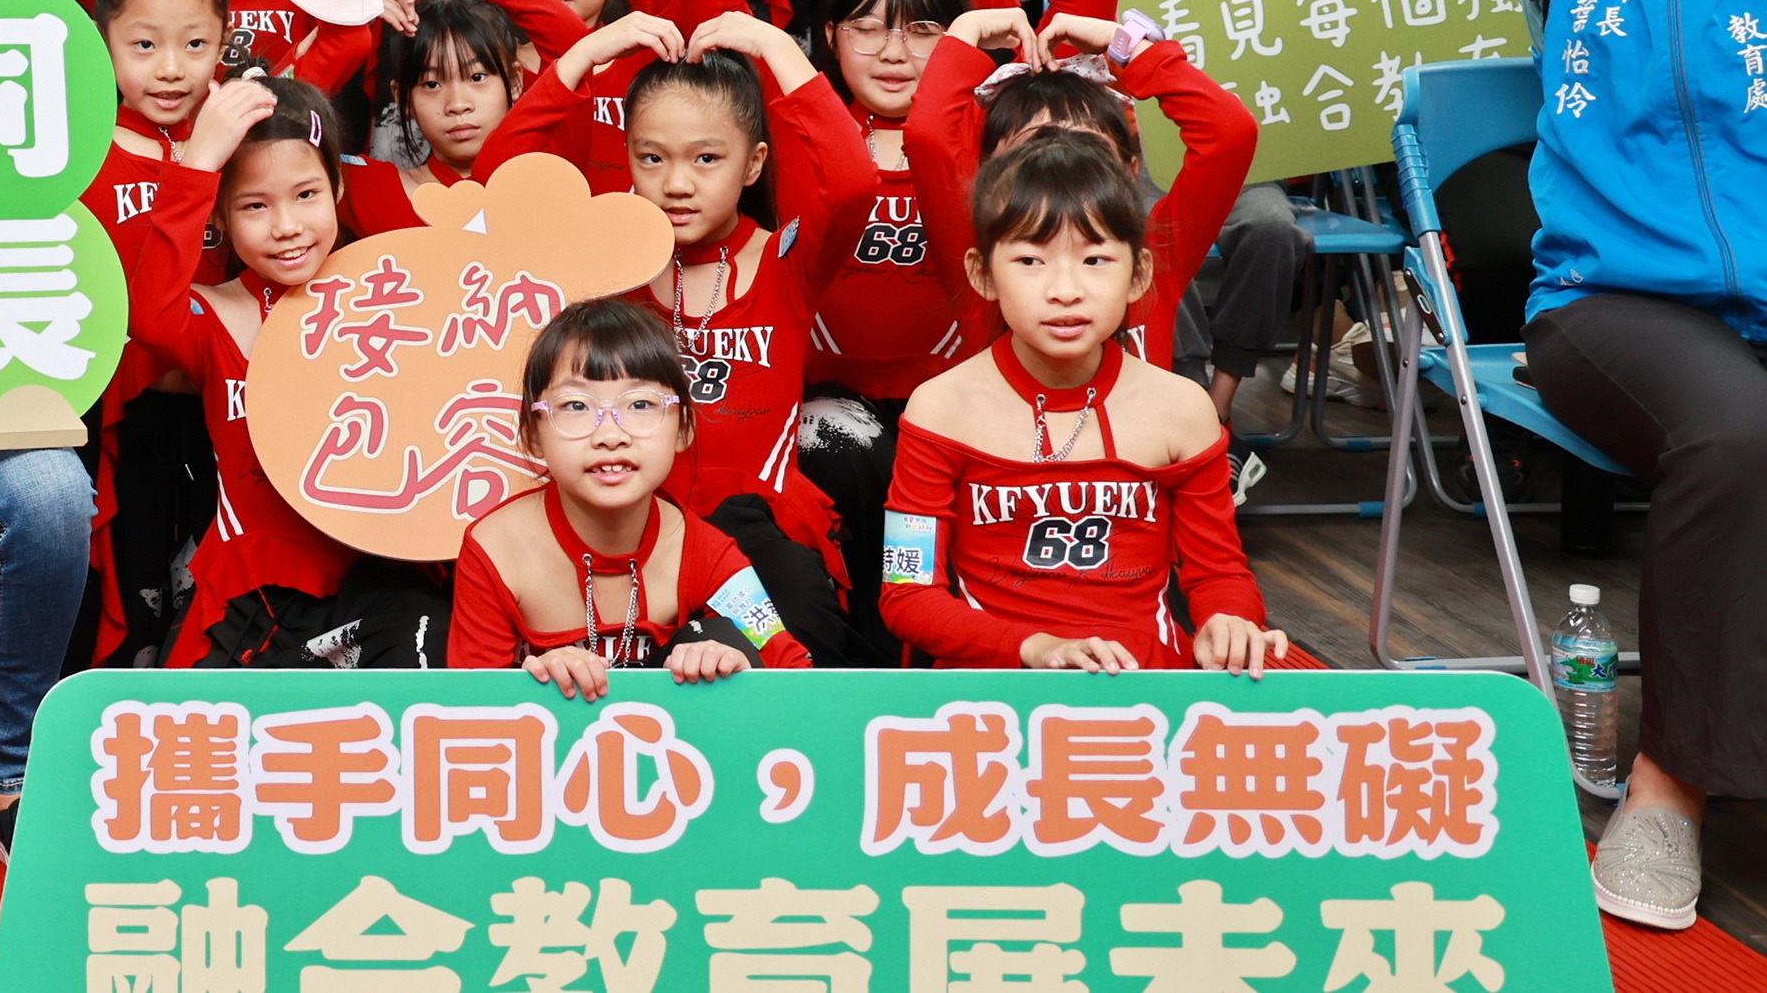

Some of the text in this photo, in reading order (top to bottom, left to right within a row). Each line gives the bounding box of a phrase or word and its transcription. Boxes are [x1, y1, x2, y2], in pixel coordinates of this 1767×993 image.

[854, 222, 928, 266] 68
[301, 256, 565, 380] 接納
[302, 381, 550, 519] 包容
[968, 480, 1159, 526] KFYUEKY
[1022, 515, 1112, 570] 68
